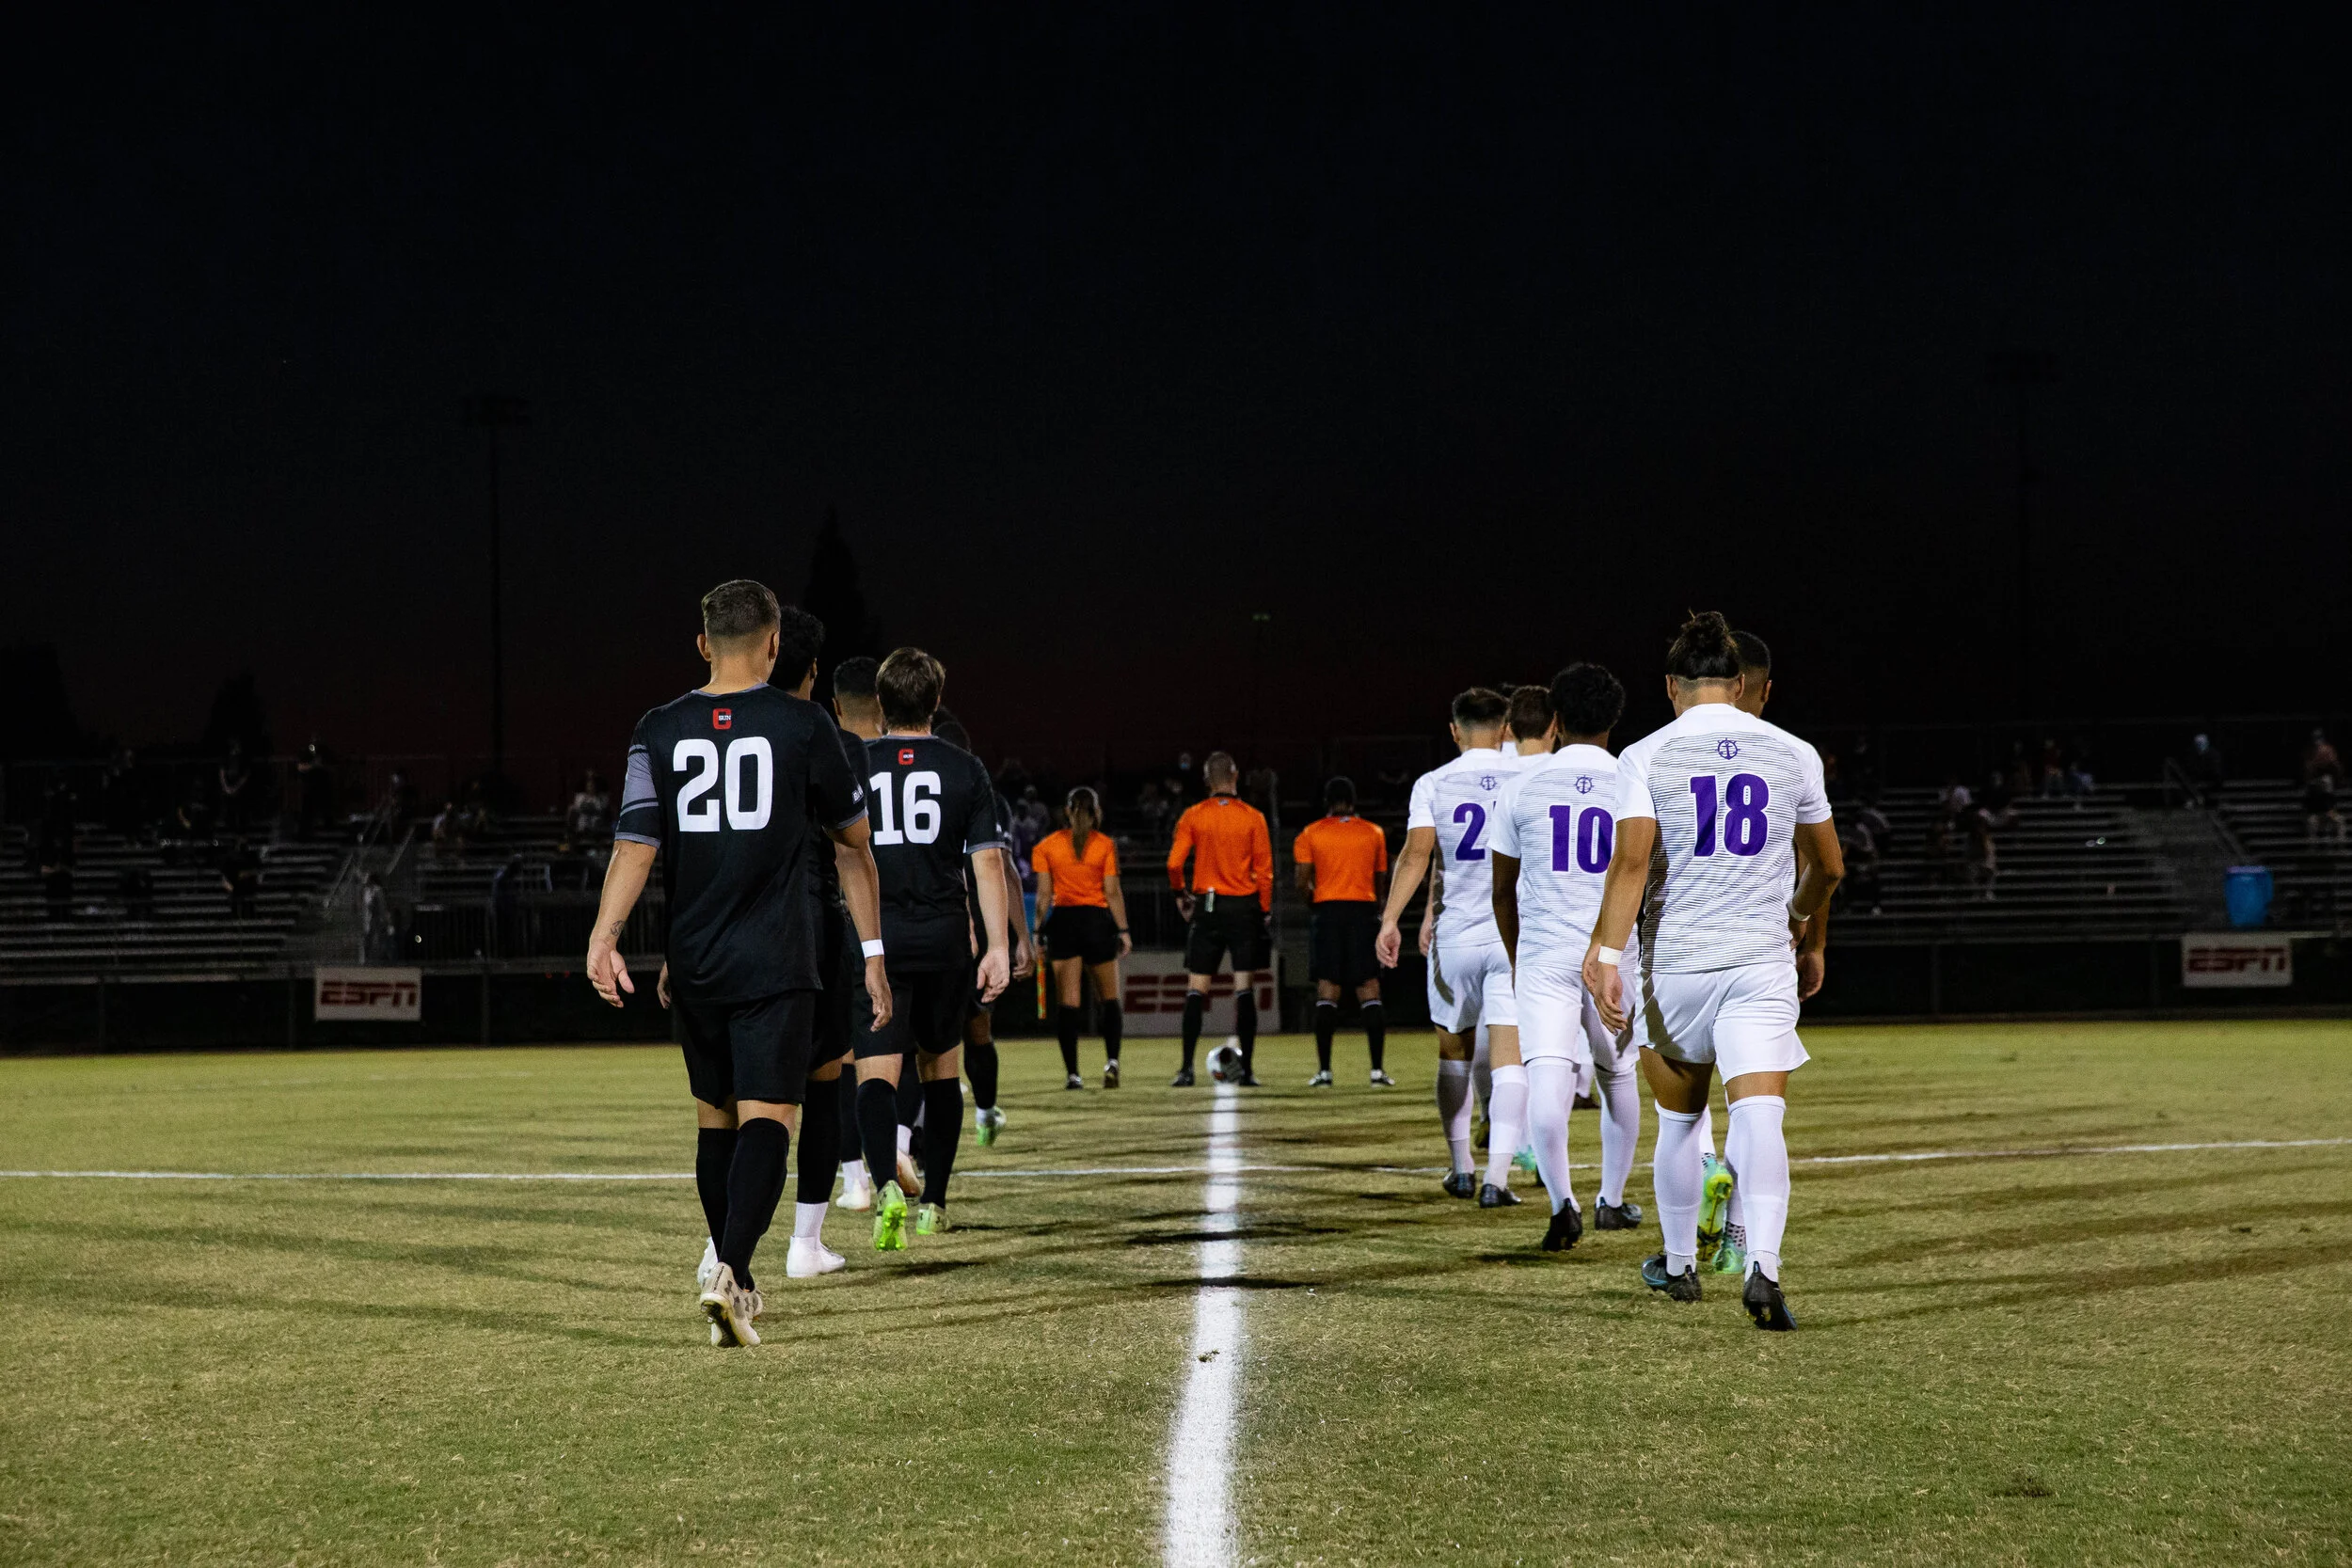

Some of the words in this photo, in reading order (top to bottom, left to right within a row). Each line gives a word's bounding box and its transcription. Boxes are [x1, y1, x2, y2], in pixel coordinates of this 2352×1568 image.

[673, 736, 773, 832] 20
[869, 771, 942, 846] 16
[1690, 773, 1770, 857] 18
[1453, 800, 1497, 861] 2
[1549, 804, 1613, 874] 10
[321, 981, 416, 1006] ESPN
[2189, 947, 2285, 971] ESPN
